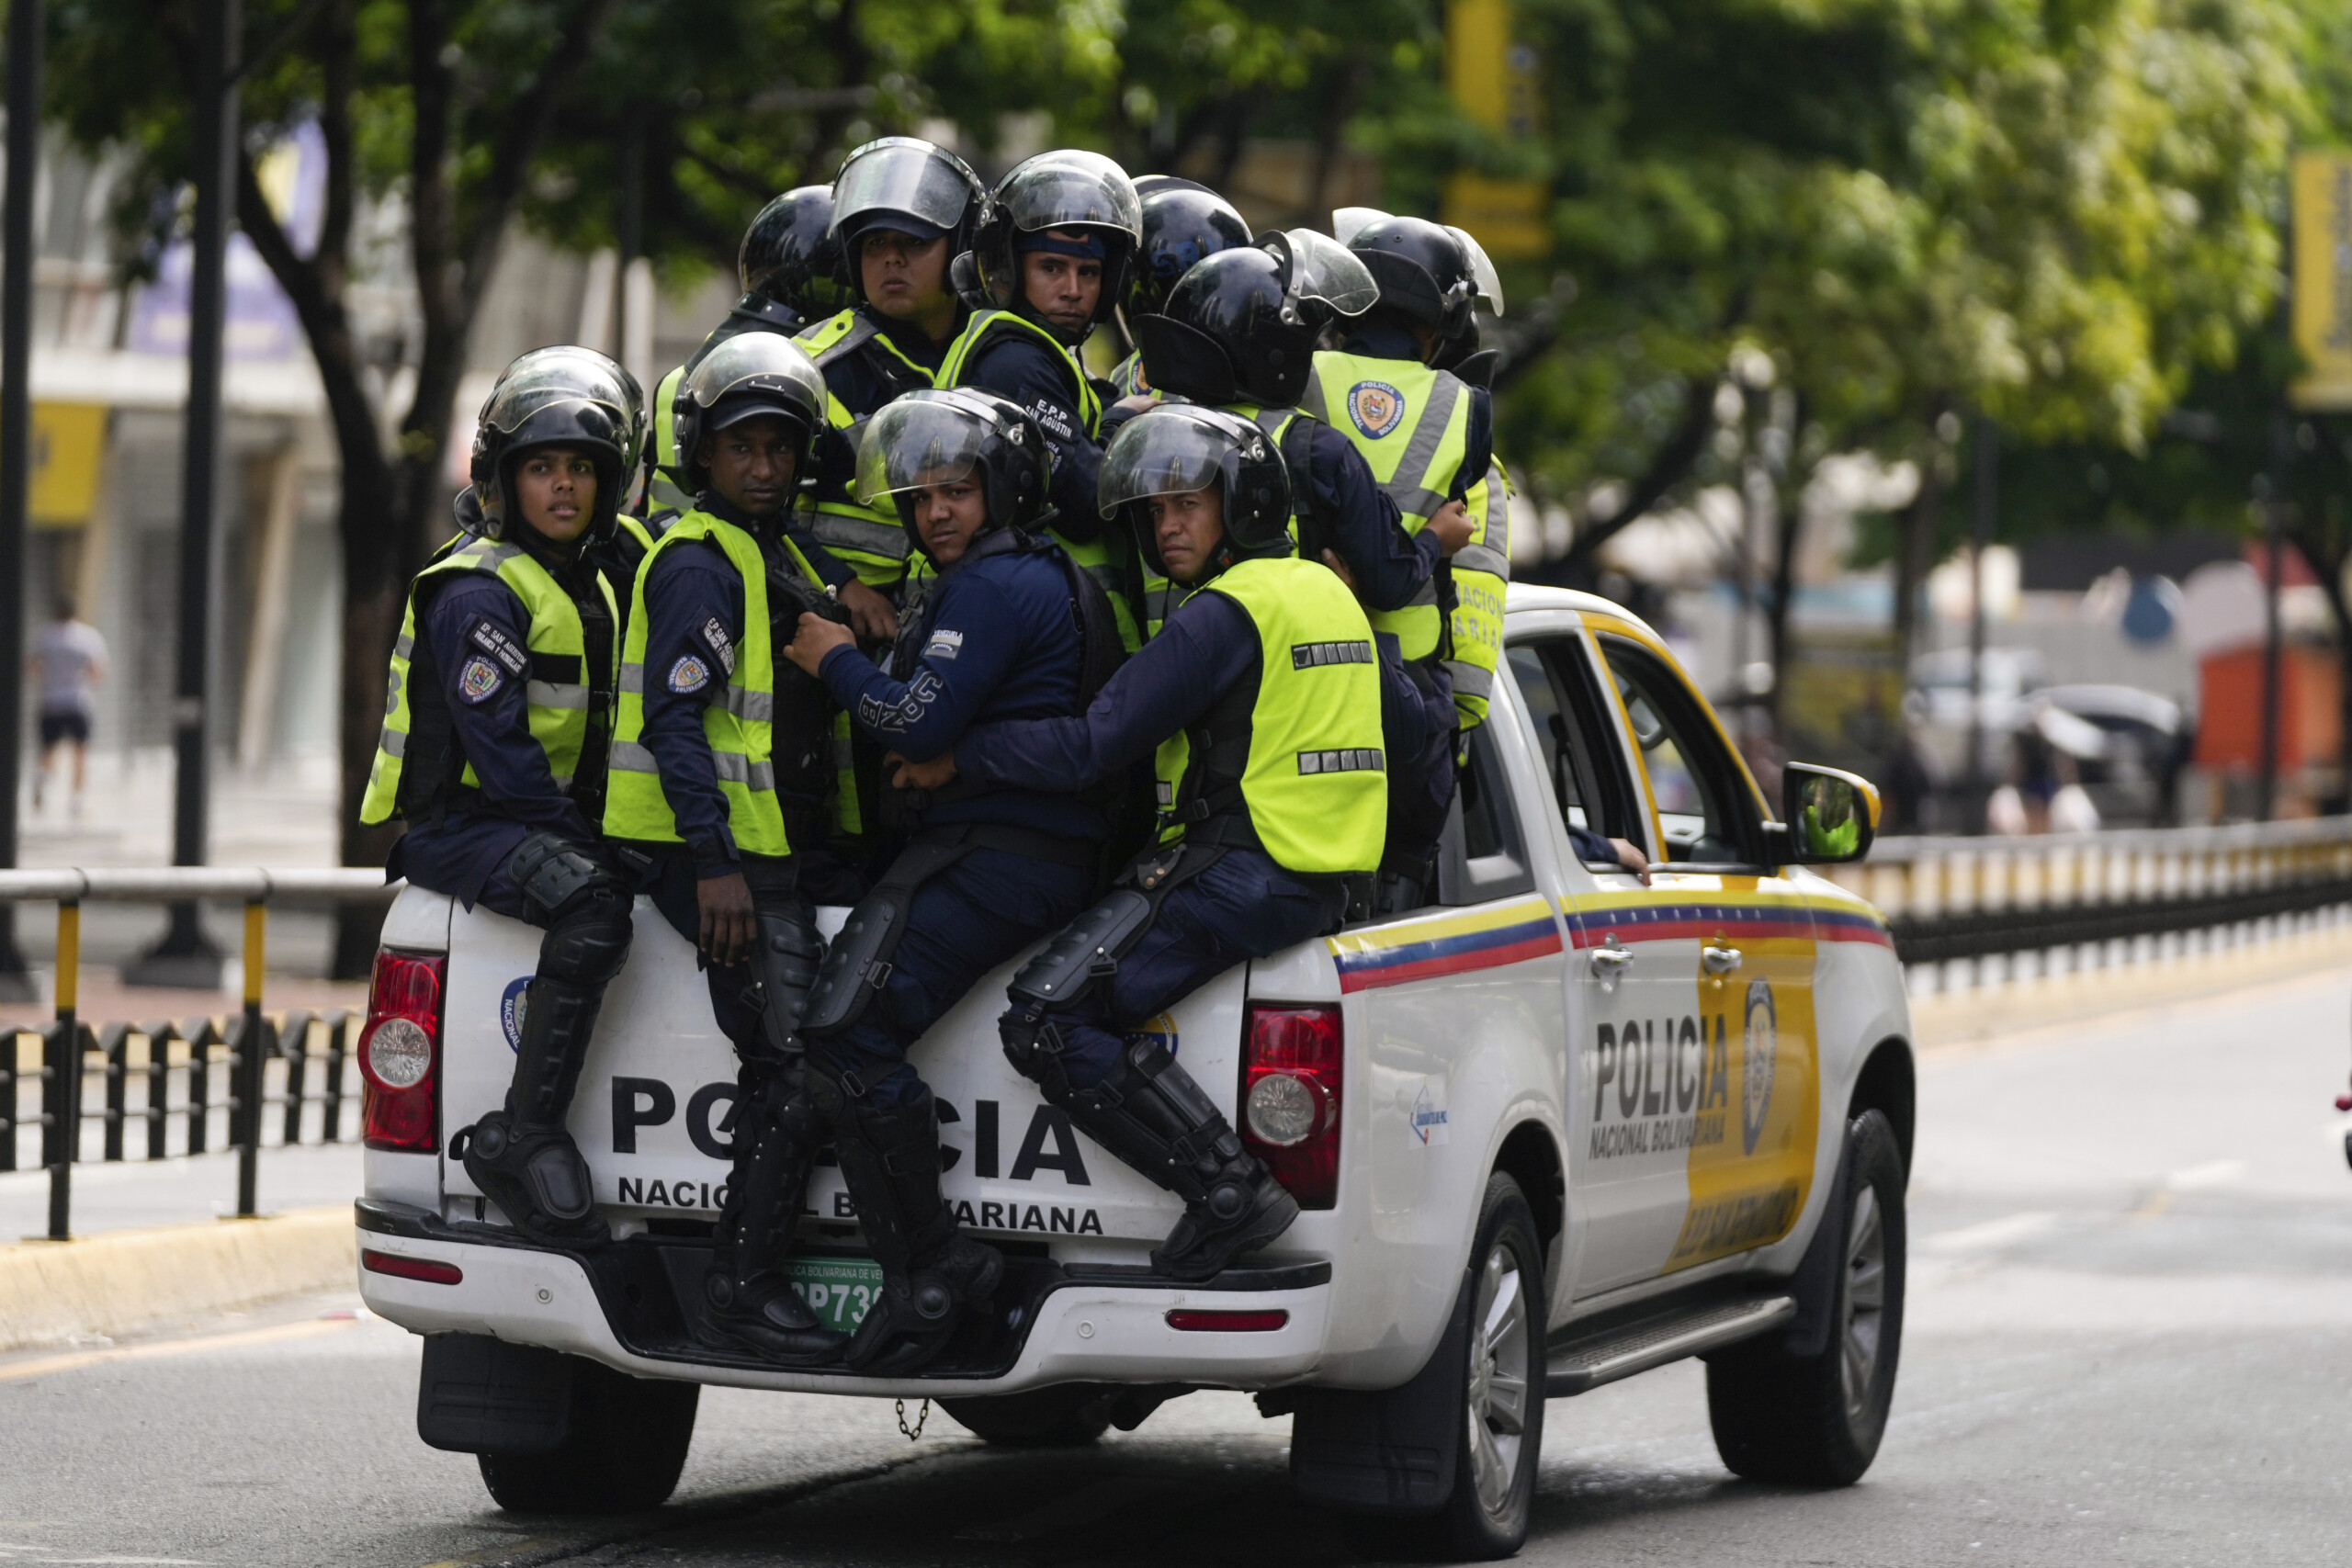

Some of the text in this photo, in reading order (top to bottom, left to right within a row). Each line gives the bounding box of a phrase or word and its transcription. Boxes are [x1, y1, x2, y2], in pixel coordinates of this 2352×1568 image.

[1361, 381, 1395, 395] POLICIA
[1025, 405, 1073, 438] SAN AGUSTIN
[1036, 399, 1068, 421] E.P.P
[1348, 392, 1364, 430] NACIONAL
[490, 630, 506, 644] SAN
[503, 641, 527, 665] AGUSTIN
[714, 627, 729, 645] SAN
[477, 656, 500, 675] POLICIA
[669, 655, 688, 685] NACIONAL
[691, 655, 710, 676] POLICIA
[503, 998, 521, 1049] NACIONAL
[1594, 1013, 1728, 1122] POLICIA
[1589, 1113, 1726, 1160] NACIONAL BOLIVARIANA
[808, 1266, 858, 1279] BOLIVARIANA
[858, 1269, 869, 1280] DE
